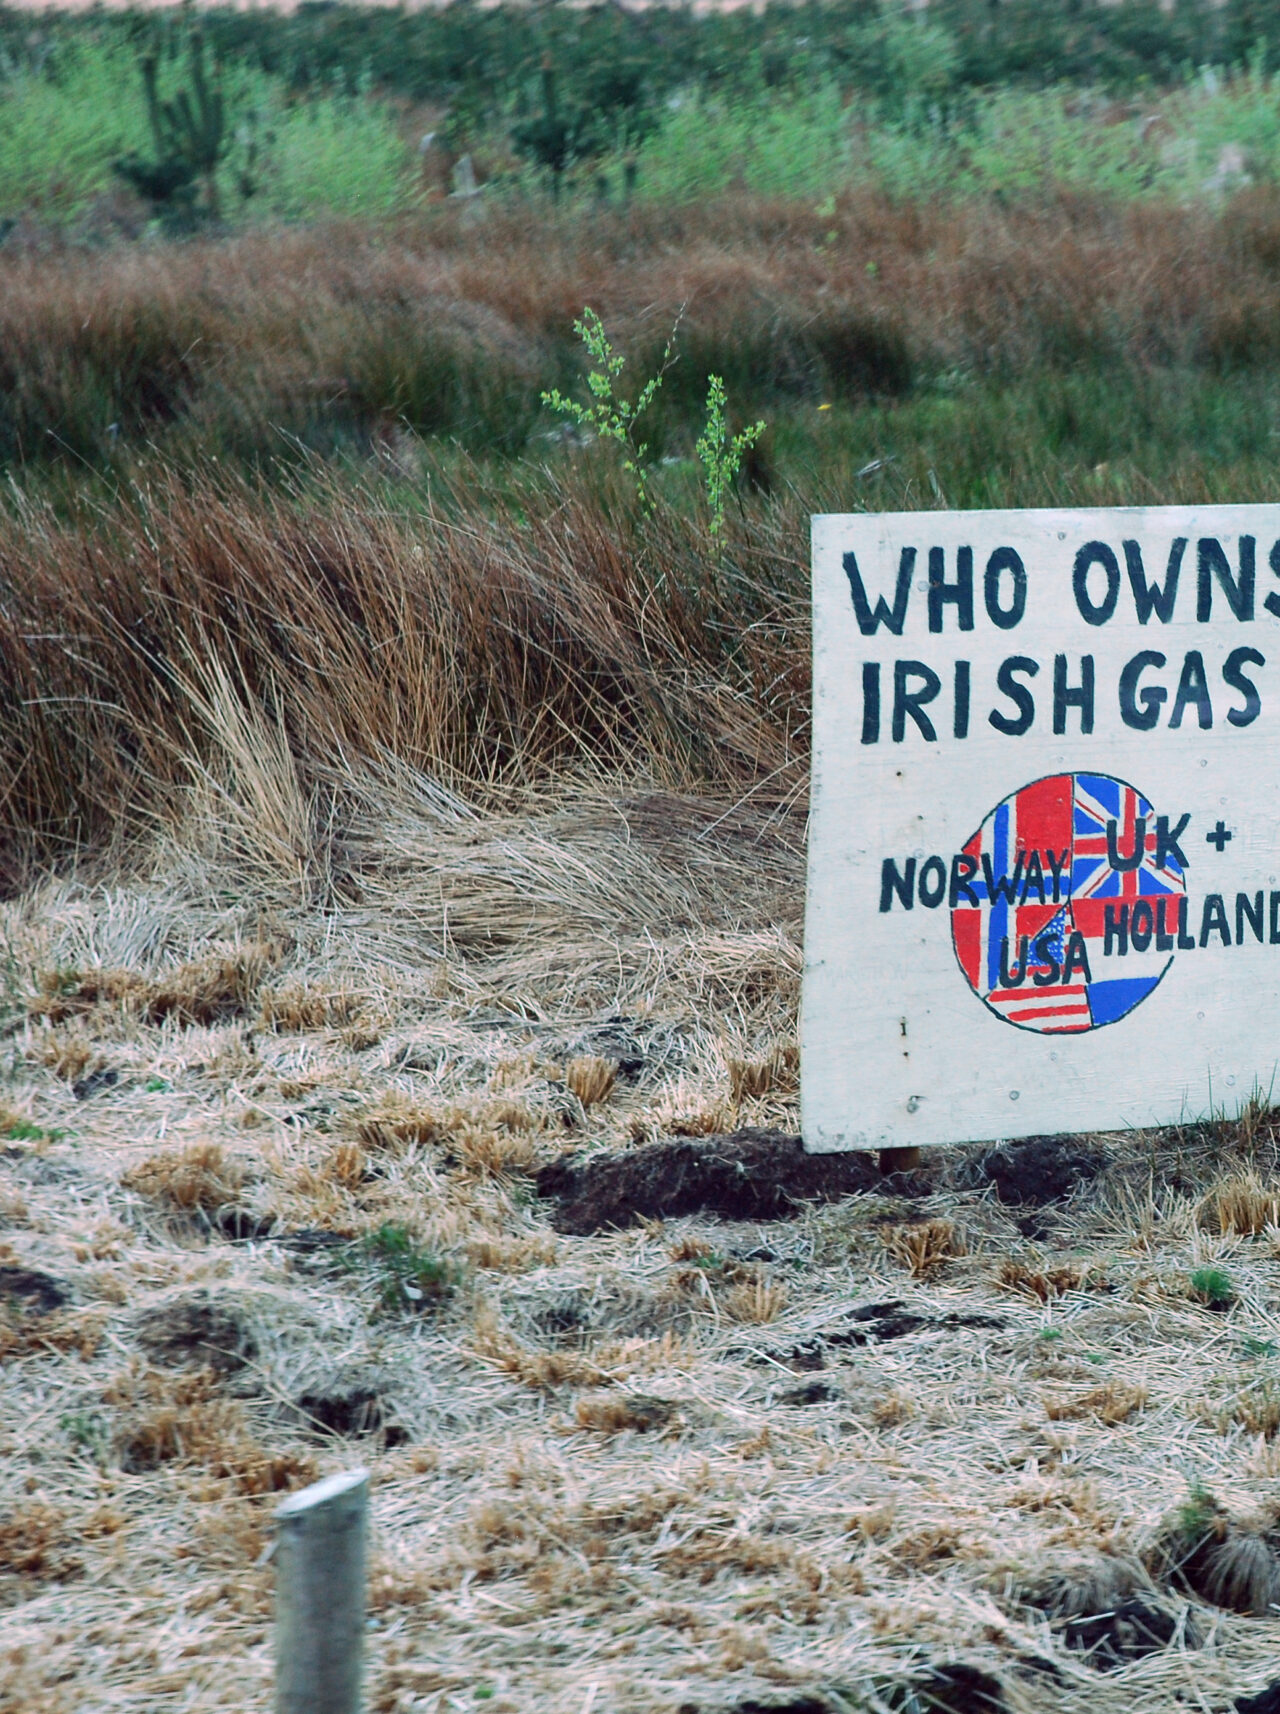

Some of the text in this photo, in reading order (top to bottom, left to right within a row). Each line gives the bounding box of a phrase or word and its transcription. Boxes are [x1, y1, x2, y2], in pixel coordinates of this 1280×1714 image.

[842, 546, 1027, 636] WHO
[860, 654, 1095, 744] IRISH
[879, 848, 1069, 913] NORWAY
[998, 931, 1092, 988] USA
